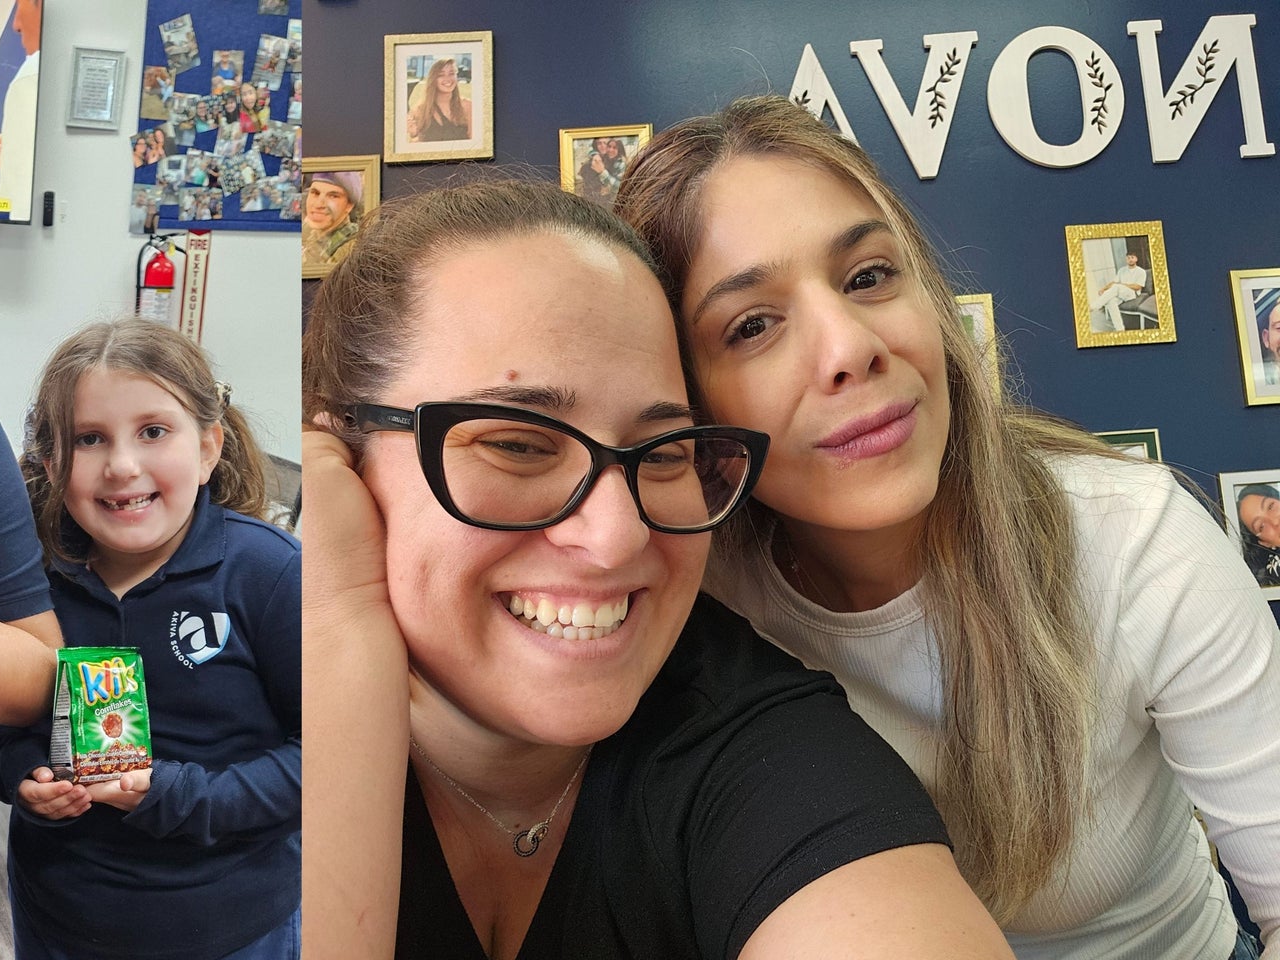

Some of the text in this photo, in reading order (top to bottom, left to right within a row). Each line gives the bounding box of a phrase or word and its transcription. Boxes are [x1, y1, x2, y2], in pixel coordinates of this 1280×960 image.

[190, 239, 208, 251] FIRE
[187, 254, 200, 336] EXTINGUISH
[169, 611, 194, 670] AKIVA SCHOOL
[94, 698, 132, 716] Cornflakes
